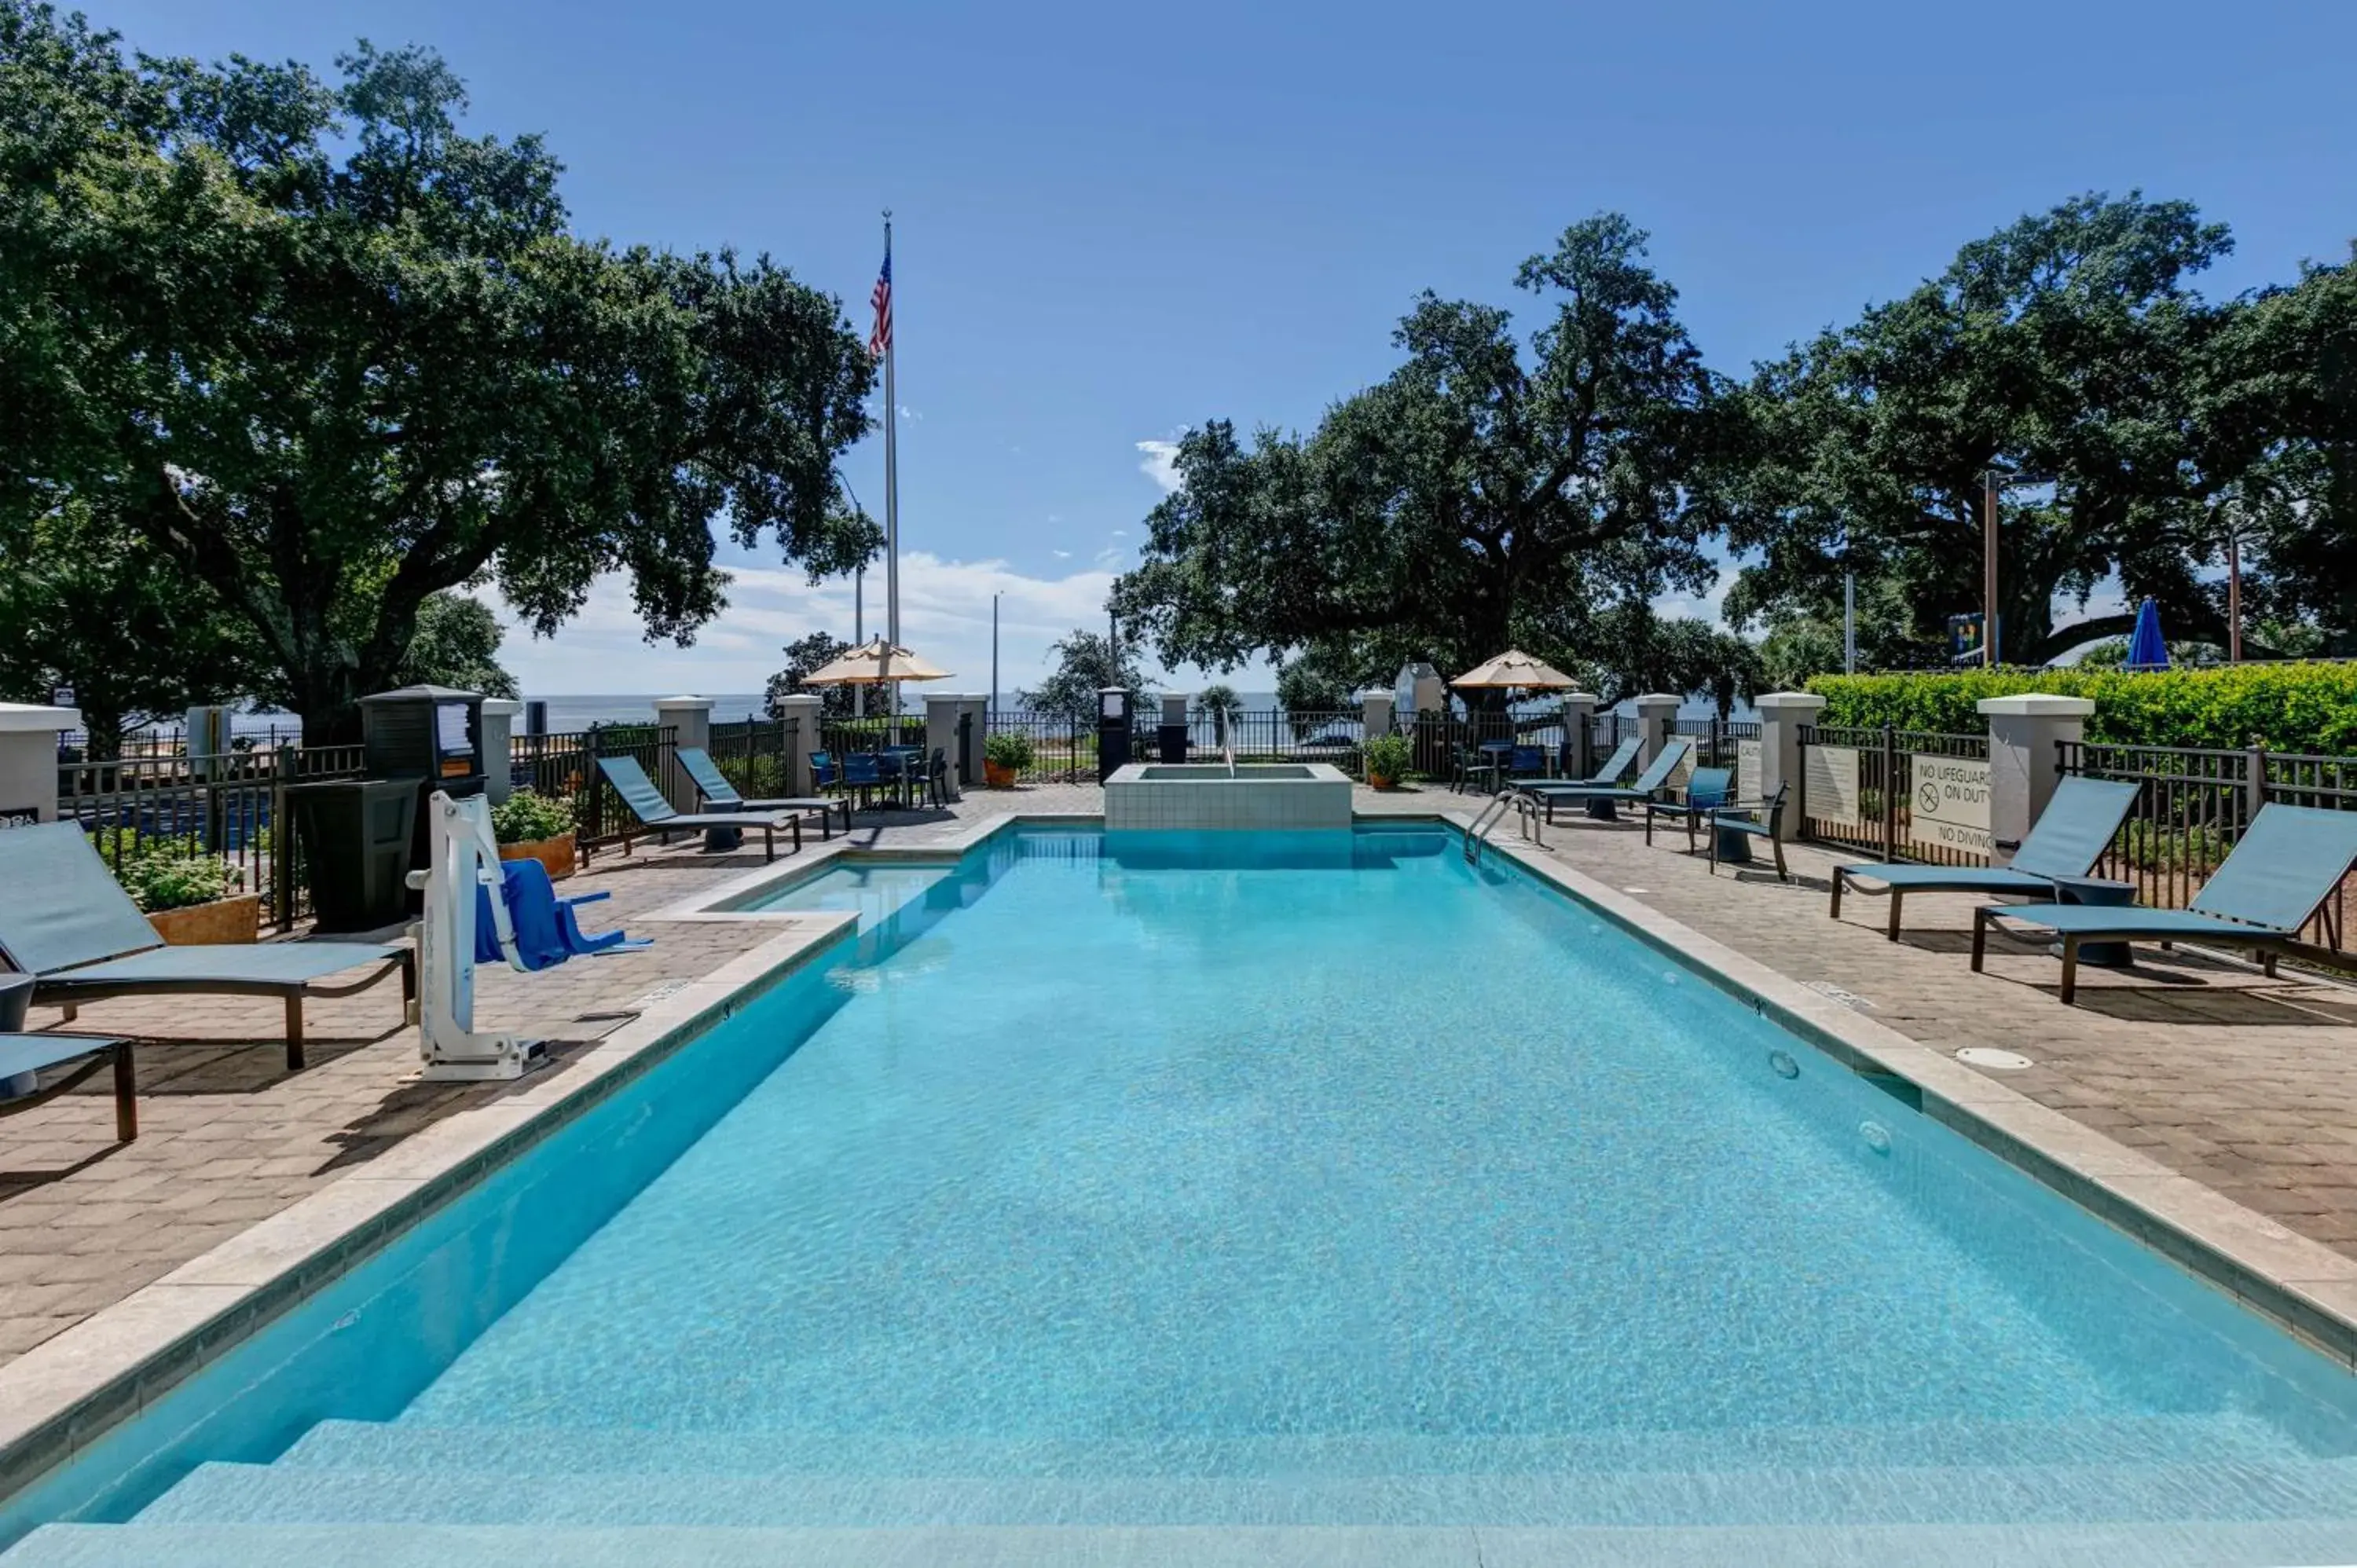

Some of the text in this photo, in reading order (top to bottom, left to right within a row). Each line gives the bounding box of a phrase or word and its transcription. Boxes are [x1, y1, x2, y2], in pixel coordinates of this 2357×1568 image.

[1919, 764, 1934, 778] NO
[1945, 784, 1960, 800] ON
[1939, 826, 1995, 848] NO DIVING
